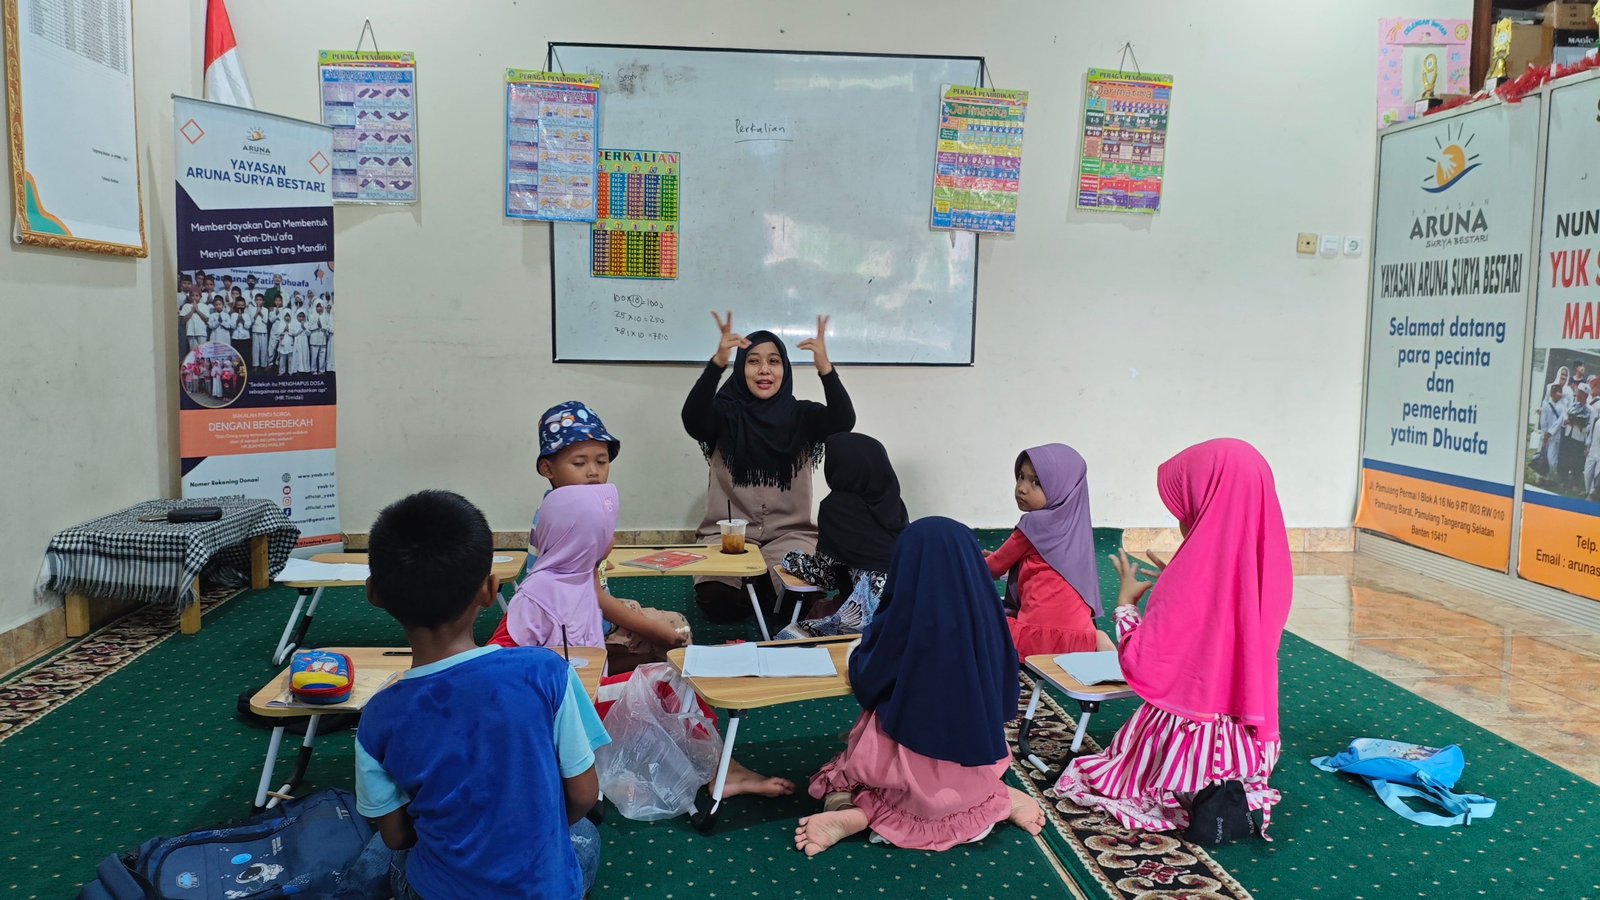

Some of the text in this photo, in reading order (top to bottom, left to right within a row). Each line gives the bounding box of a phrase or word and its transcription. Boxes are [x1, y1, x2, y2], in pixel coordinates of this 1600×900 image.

[519, 72, 546, 81] PERAGA
[1099, 72, 1161, 82] PERAGA PENDIDIKAN
[953, 88, 1016, 99] PERAGA PENDIDIKAN
[735, 118, 786, 134] Perkalian
[242, 145, 271, 154] ARUNA
[230, 158, 286, 176] YAYASAN
[186, 166, 326, 193] ARUNA SURYA BESTARI
[190, 218, 328, 233] Memberdayakan Dan Membentuk
[1409, 207, 1489, 241] ARUNA
[233, 233, 294, 244] Yatim-Dhu'afa
[1425, 234, 1489, 250] SURYA BESTARI
[200, 243, 327, 260] Menjadi Generasi Yang Mandiri
[1381, 253, 1523, 298] YAYASAN ARUNA SURYA BESTARI
[1550, 248, 1591, 288] YUK
[1389, 315, 1506, 344] Selamat datang
[1397, 346, 1491, 370] para pecinta
[1426, 370, 1454, 393] dan
[1402, 400, 1477, 425] pemerhati
[208, 418, 313, 432] DENGAN BERSEDEKAH
[1390, 425, 1488, 455] yatim Dhuafa
[211, 478, 239, 486] Rekening
[1375, 482, 1399, 498] Pamulang
[1399, 487, 1417, 500] Permai
[1420, 491, 1433, 504] Blok
[1433, 495, 1438, 505] A
[1439, 496, 1446, 508] 16
[1446, 498, 1455, 509] No
[1455, 500, 1460, 510] 9
[1460, 501, 1469, 512] RT
[1469, 503, 1480, 516] 003
[1481, 505, 1493, 517] RW
[1492, 508, 1505, 521] 010
[1374, 498, 1398, 515] Pamulang
[1414, 507, 1440, 526] Pamulang
[1441, 514, 1471, 534] Tangerang
[1471, 522, 1495, 538] Selatan
[1411, 524, 1448, 543] Banten 15417
[1575, 535, 1598, 554] Telp.
[1536, 548, 1561, 567] Email
